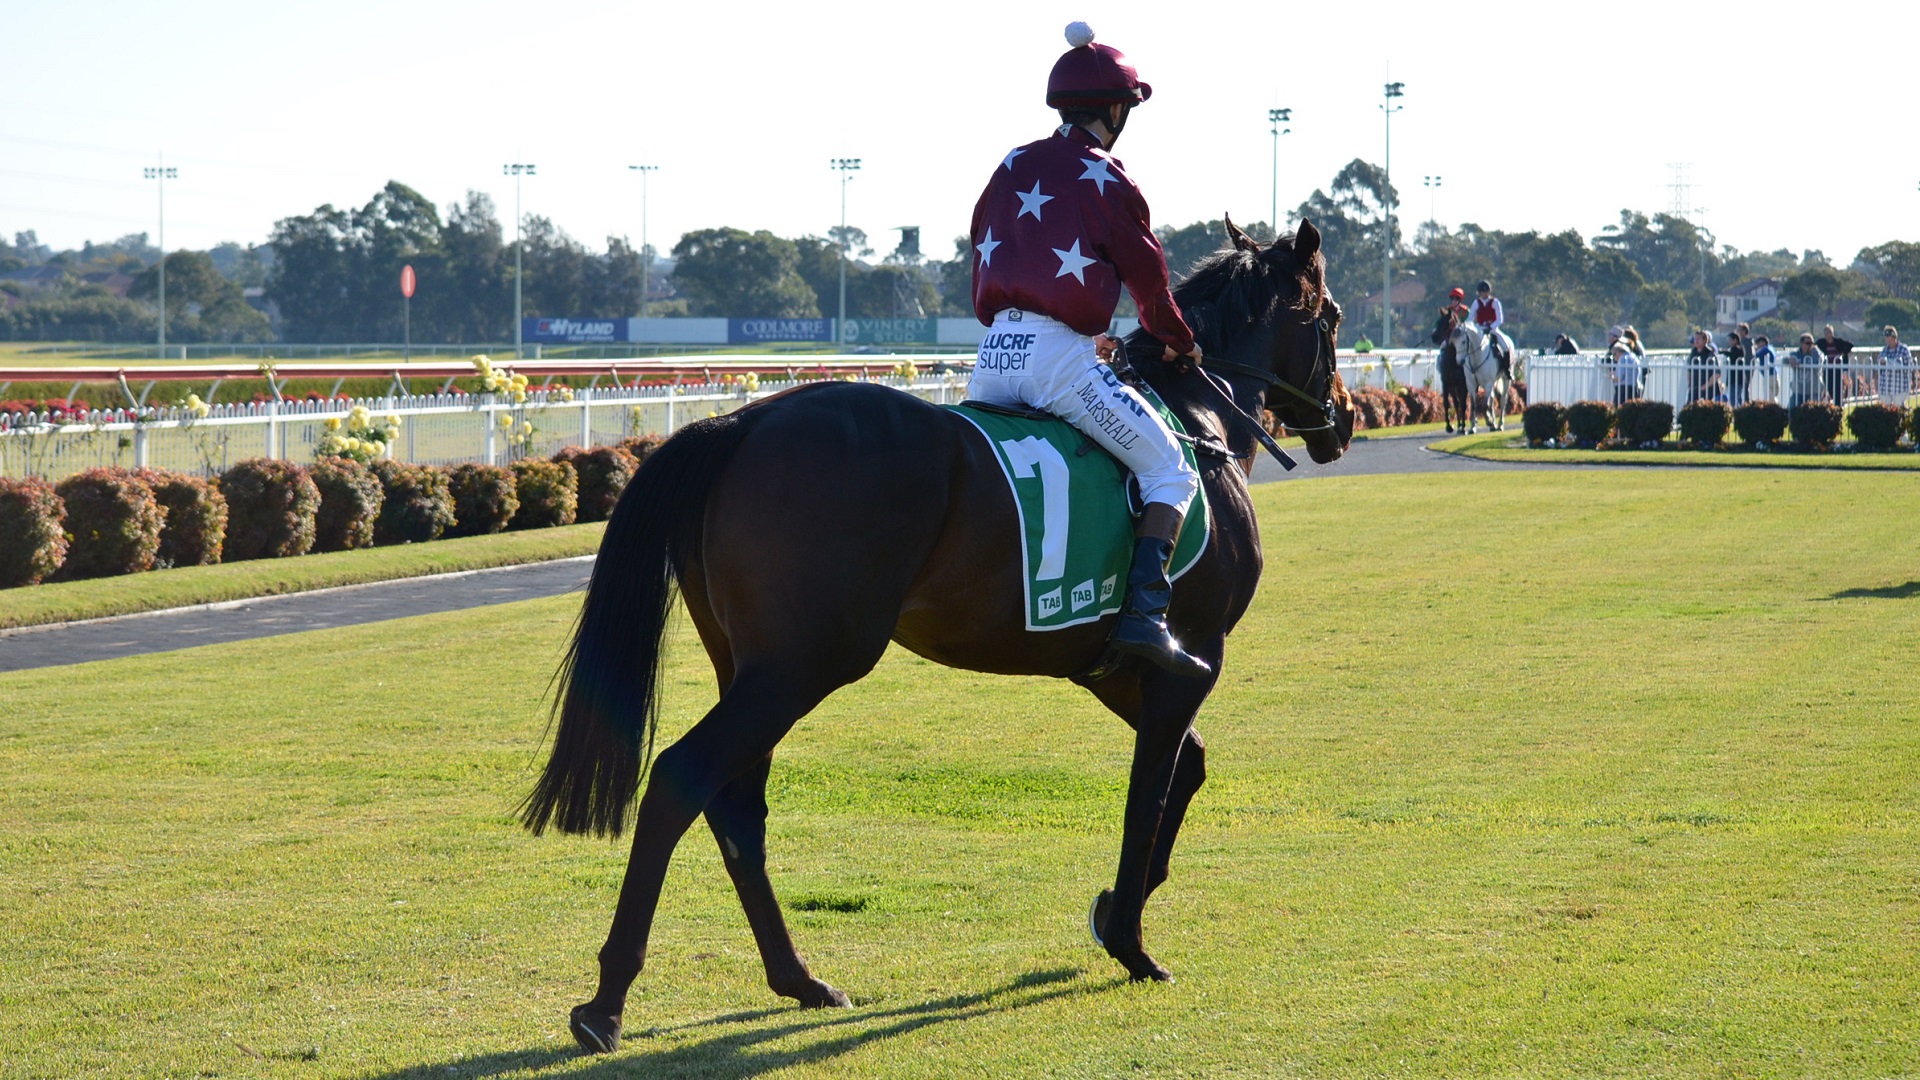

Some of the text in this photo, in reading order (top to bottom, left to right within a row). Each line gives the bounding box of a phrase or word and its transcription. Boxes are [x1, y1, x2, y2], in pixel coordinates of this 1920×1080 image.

[551, 319, 615, 335] HYLAND
[742, 320, 824, 335] COOLMORE
[861, 319, 928, 331] VINERY
[874, 331, 915, 342] STUD
[982, 333, 1036, 349] LUCRF
[979, 350, 1031, 374] super
[1077, 381, 1140, 450] MARSHALL
[1041, 596, 1061, 609] TAB
[1073, 589, 1093, 603] TAB
